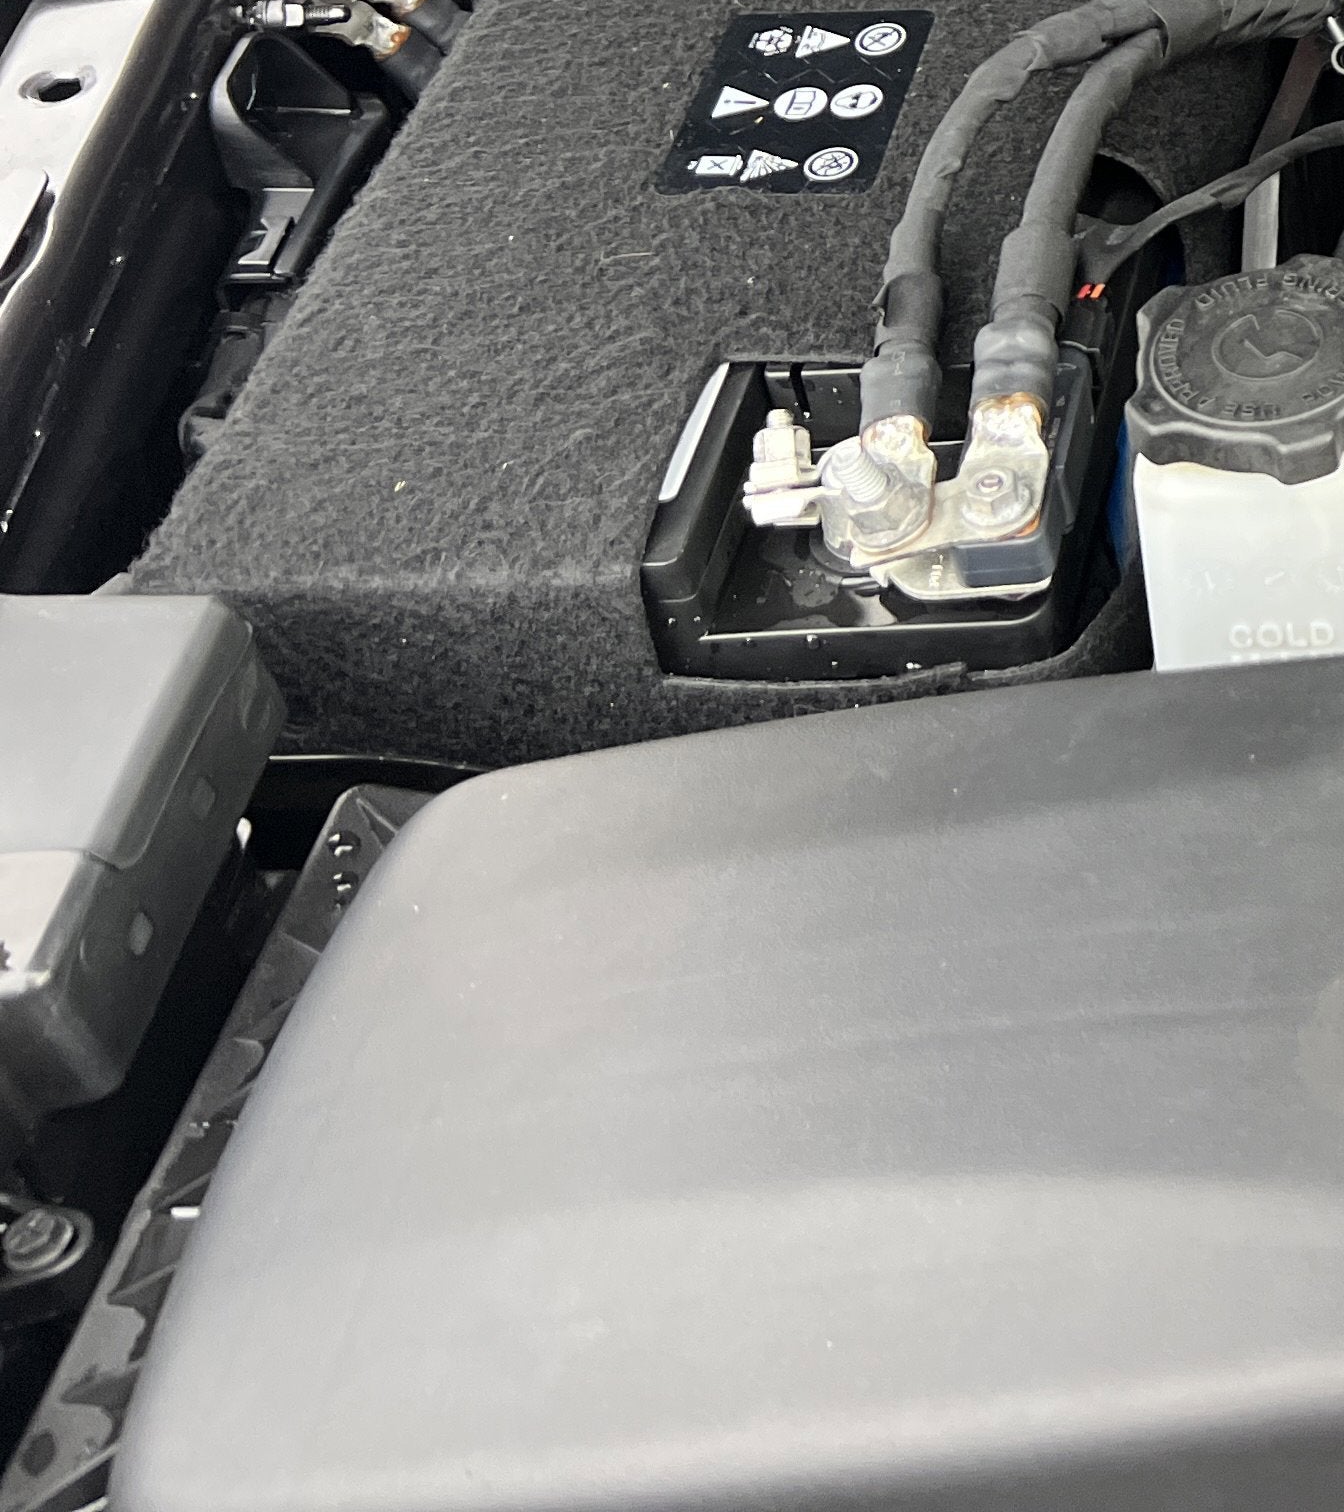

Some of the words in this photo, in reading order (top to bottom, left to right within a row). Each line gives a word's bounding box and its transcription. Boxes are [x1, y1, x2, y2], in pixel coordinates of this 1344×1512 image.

[1195, 274, 1269, 312] FLUID
[1157, 318, 1216, 407] APPROVED
[1229, 620, 1335, 649] COLD
